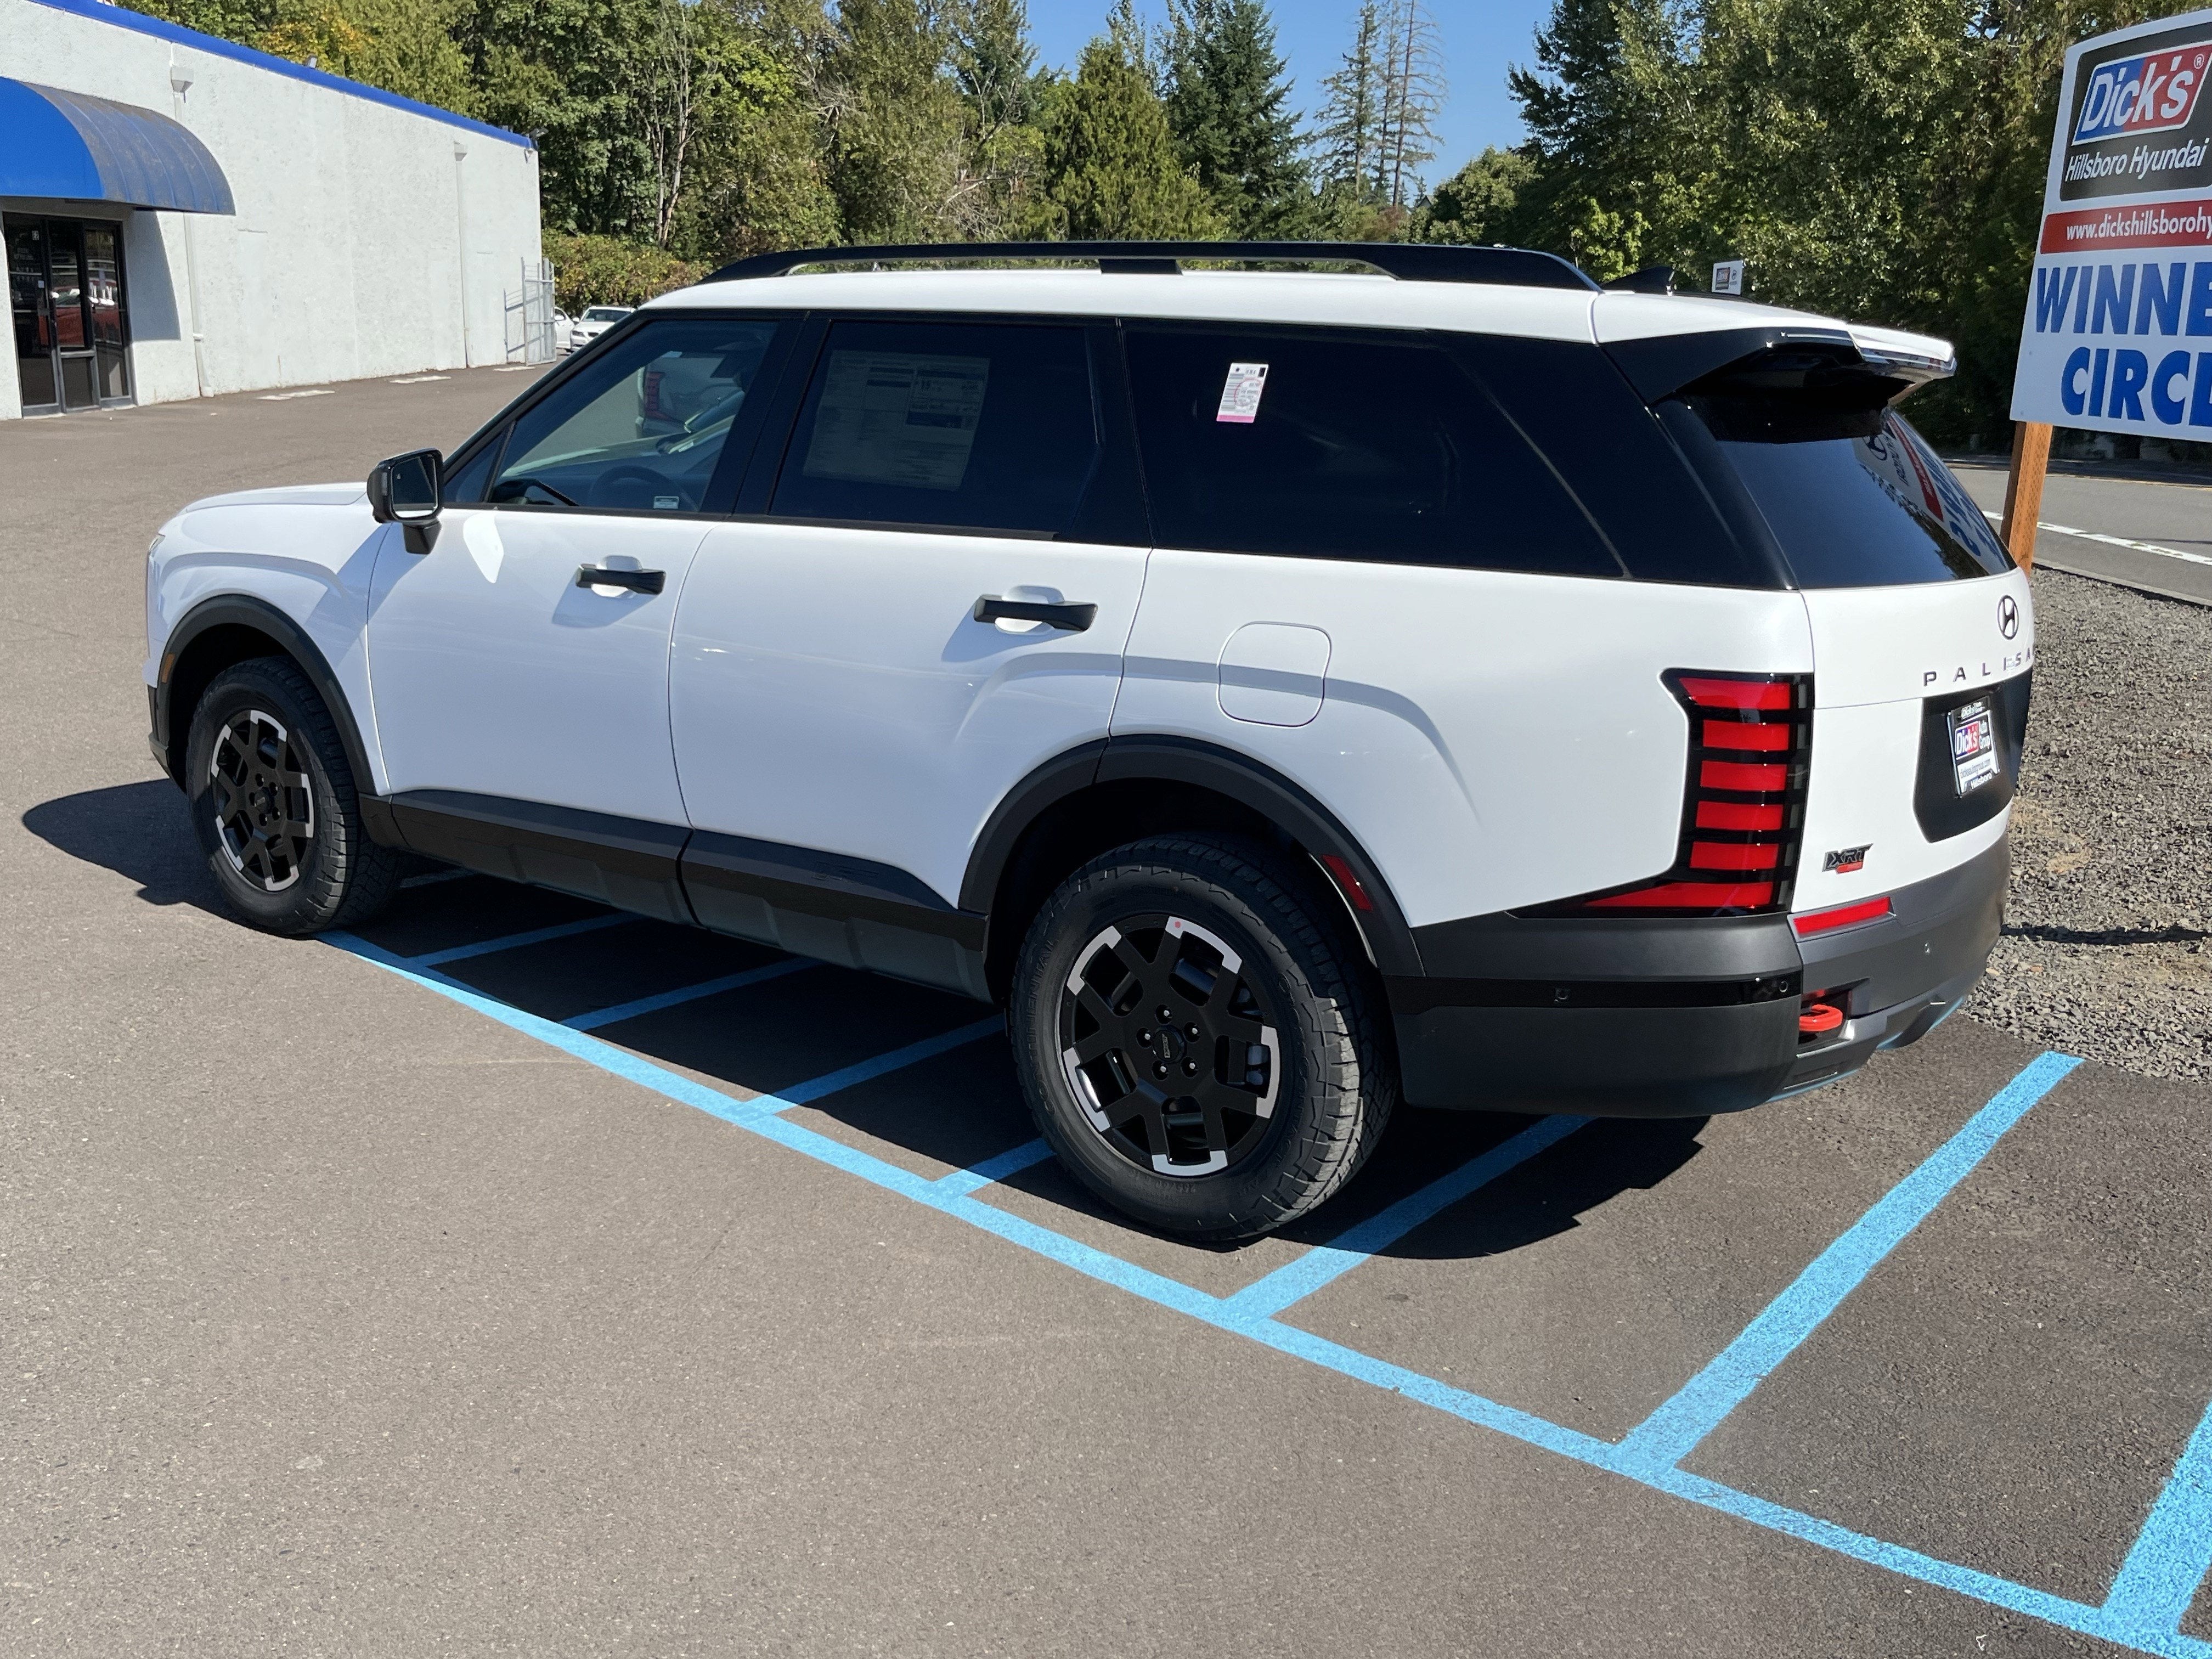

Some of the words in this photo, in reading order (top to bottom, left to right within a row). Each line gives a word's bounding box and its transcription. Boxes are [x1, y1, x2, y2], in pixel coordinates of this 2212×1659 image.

[2081, 55, 2194, 132] Dick's
[2065, 152, 2128, 182] Hillsboro
[2128, 137, 2210, 180] Hyundai
